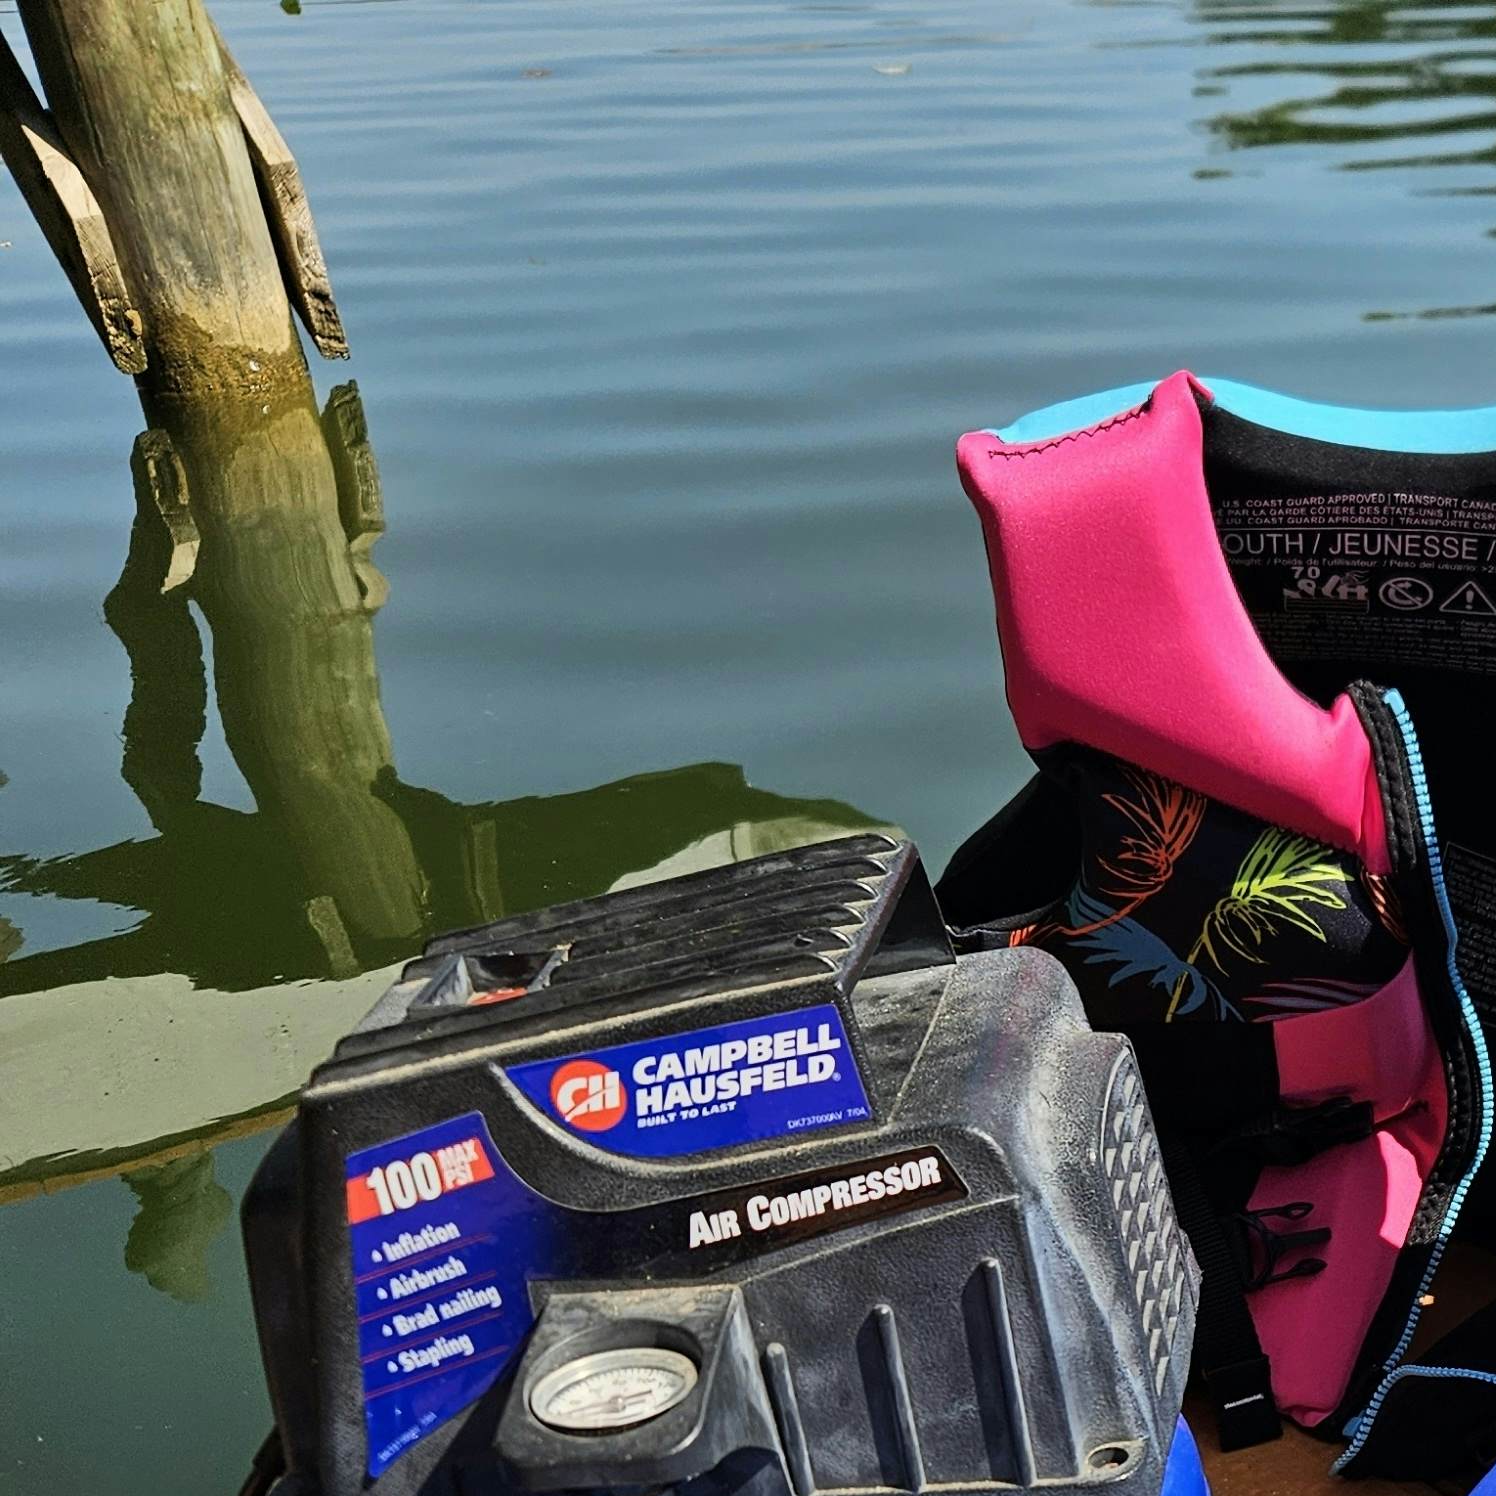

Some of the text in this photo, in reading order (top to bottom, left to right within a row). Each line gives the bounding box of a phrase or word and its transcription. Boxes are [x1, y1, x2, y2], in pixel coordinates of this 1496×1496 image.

[1246, 498, 1283, 508] COAST
[1286, 496, 1326, 507] GUARD
[1327, 493, 1386, 506] APPROVED
[1393, 493, 1459, 509] TRANSPORT
[1359, 505, 1380, 515] DES
[1247, 516, 1284, 526] COAST
[1286, 515, 1326, 525] GUARD
[1327, 515, 1389, 525] APROBADO
[1399, 516, 1470, 530] TRANSPORTE
[1222, 532, 1304, 555] OUTH
[1328, 532, 1479, 560] JEUNESSE
[632, 1023, 841, 1085] CAMPBELL
[637, 1101, 738, 1129] BUILT TO LAST
[437, 1139, 479, 1170] MAX
[367, 1151, 443, 1216] 100
[690, 1156, 942, 1248] AIR COMPRESSOR
[382, 1222, 461, 1263] Inflation
[390, 1255, 468, 1300] Airbrush
[392, 1285, 502, 1336] Brad nailing
[398, 1334, 475, 1373] Stapling
